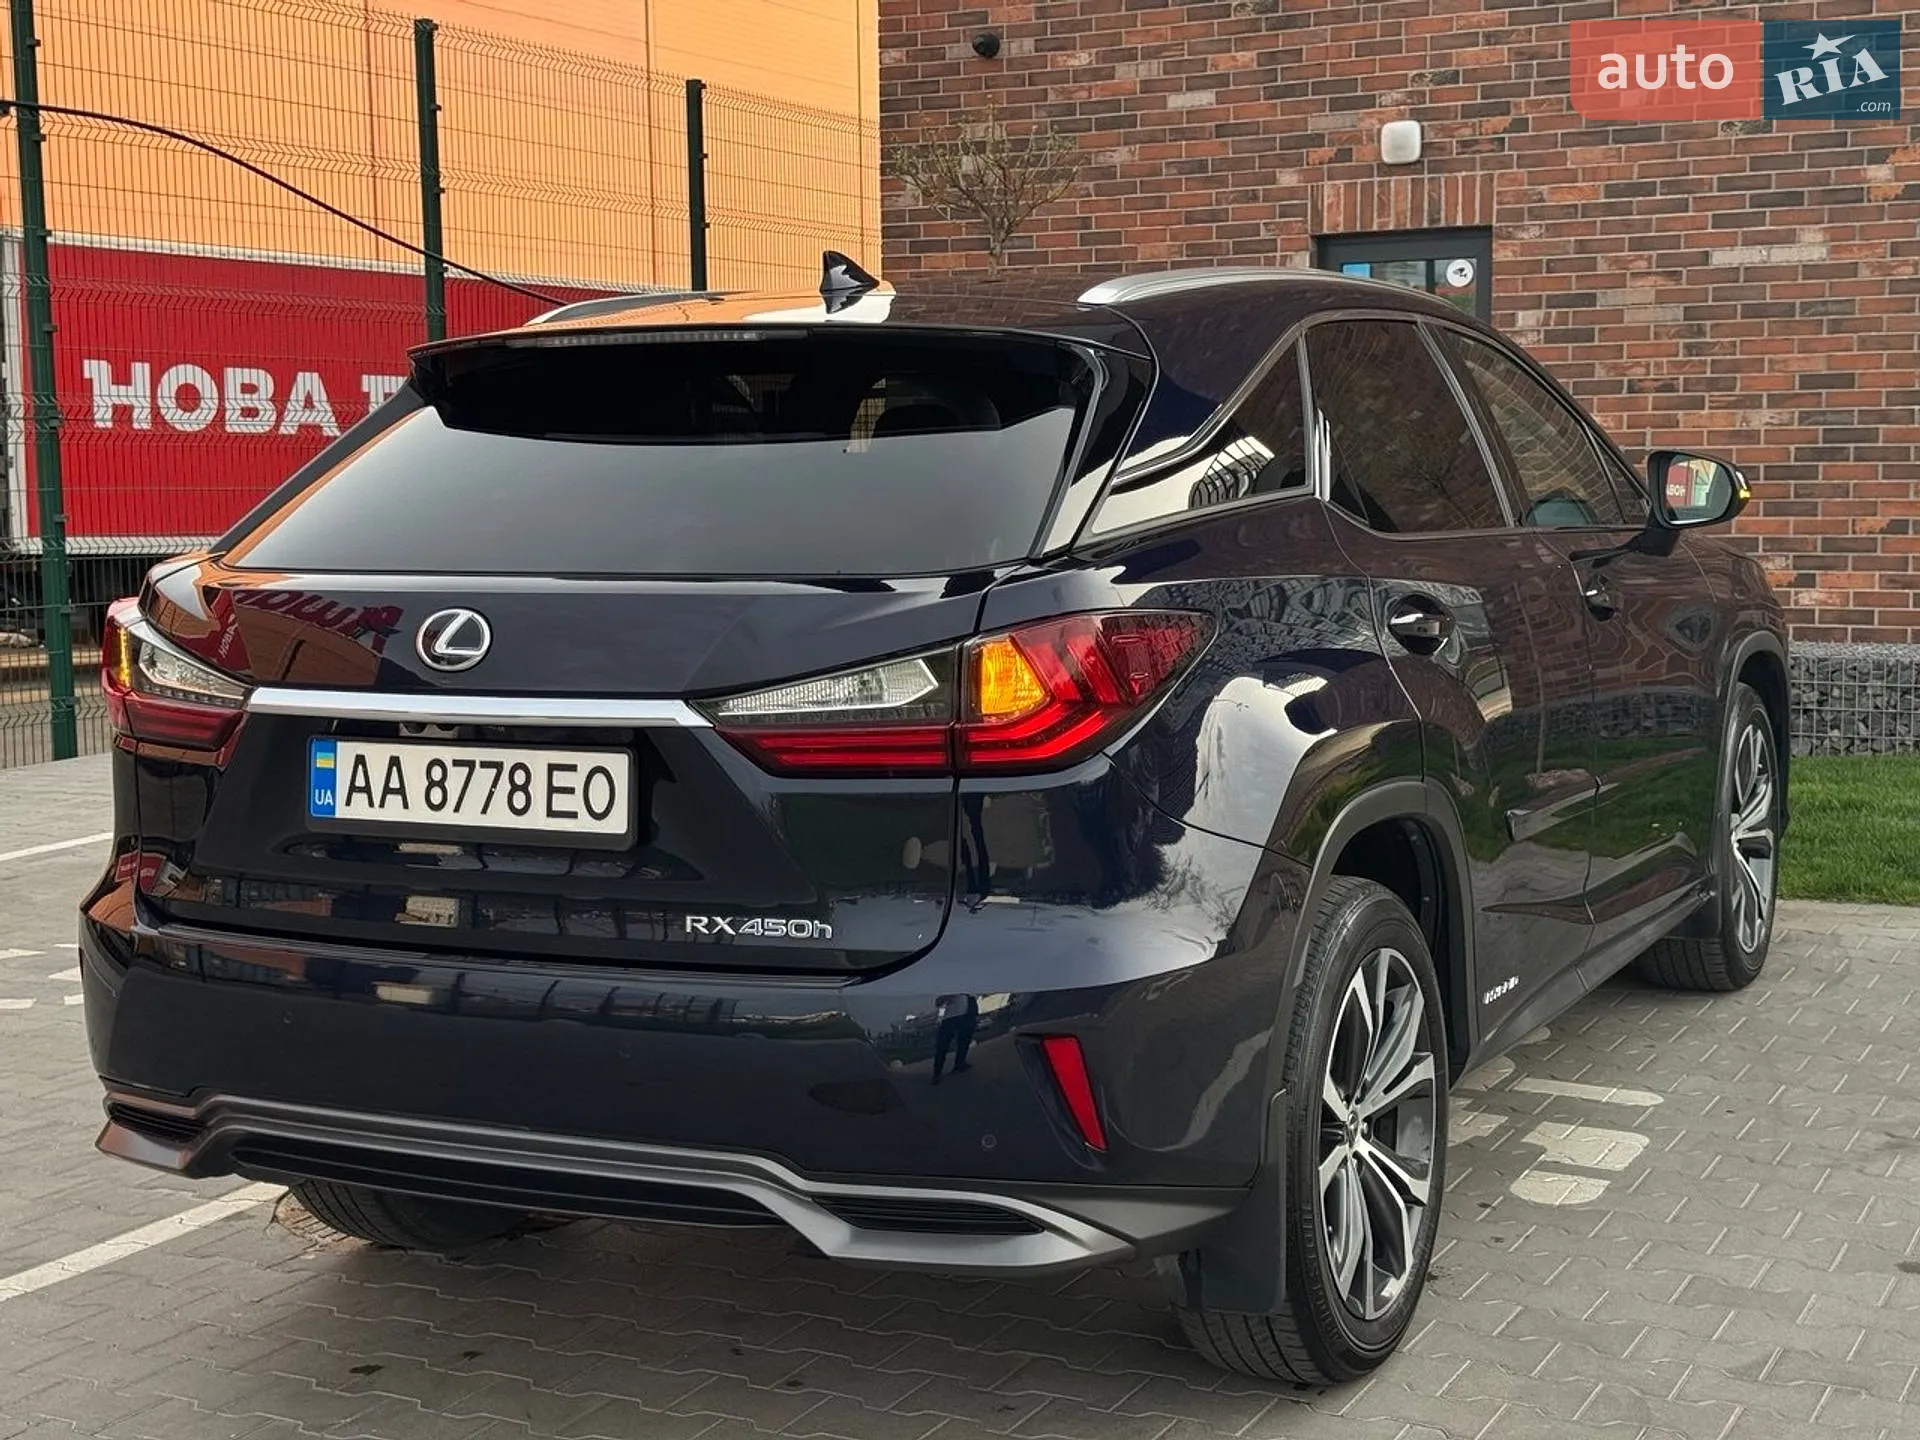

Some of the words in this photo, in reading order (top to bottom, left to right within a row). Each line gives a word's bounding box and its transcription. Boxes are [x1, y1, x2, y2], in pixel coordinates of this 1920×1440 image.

[83, 359, 341, 436] НОВА
[315, 788, 334, 807] UA
[345, 754, 409, 810] AA
[424, 758, 532, 817] 8778
[546, 763, 616, 821] EO
